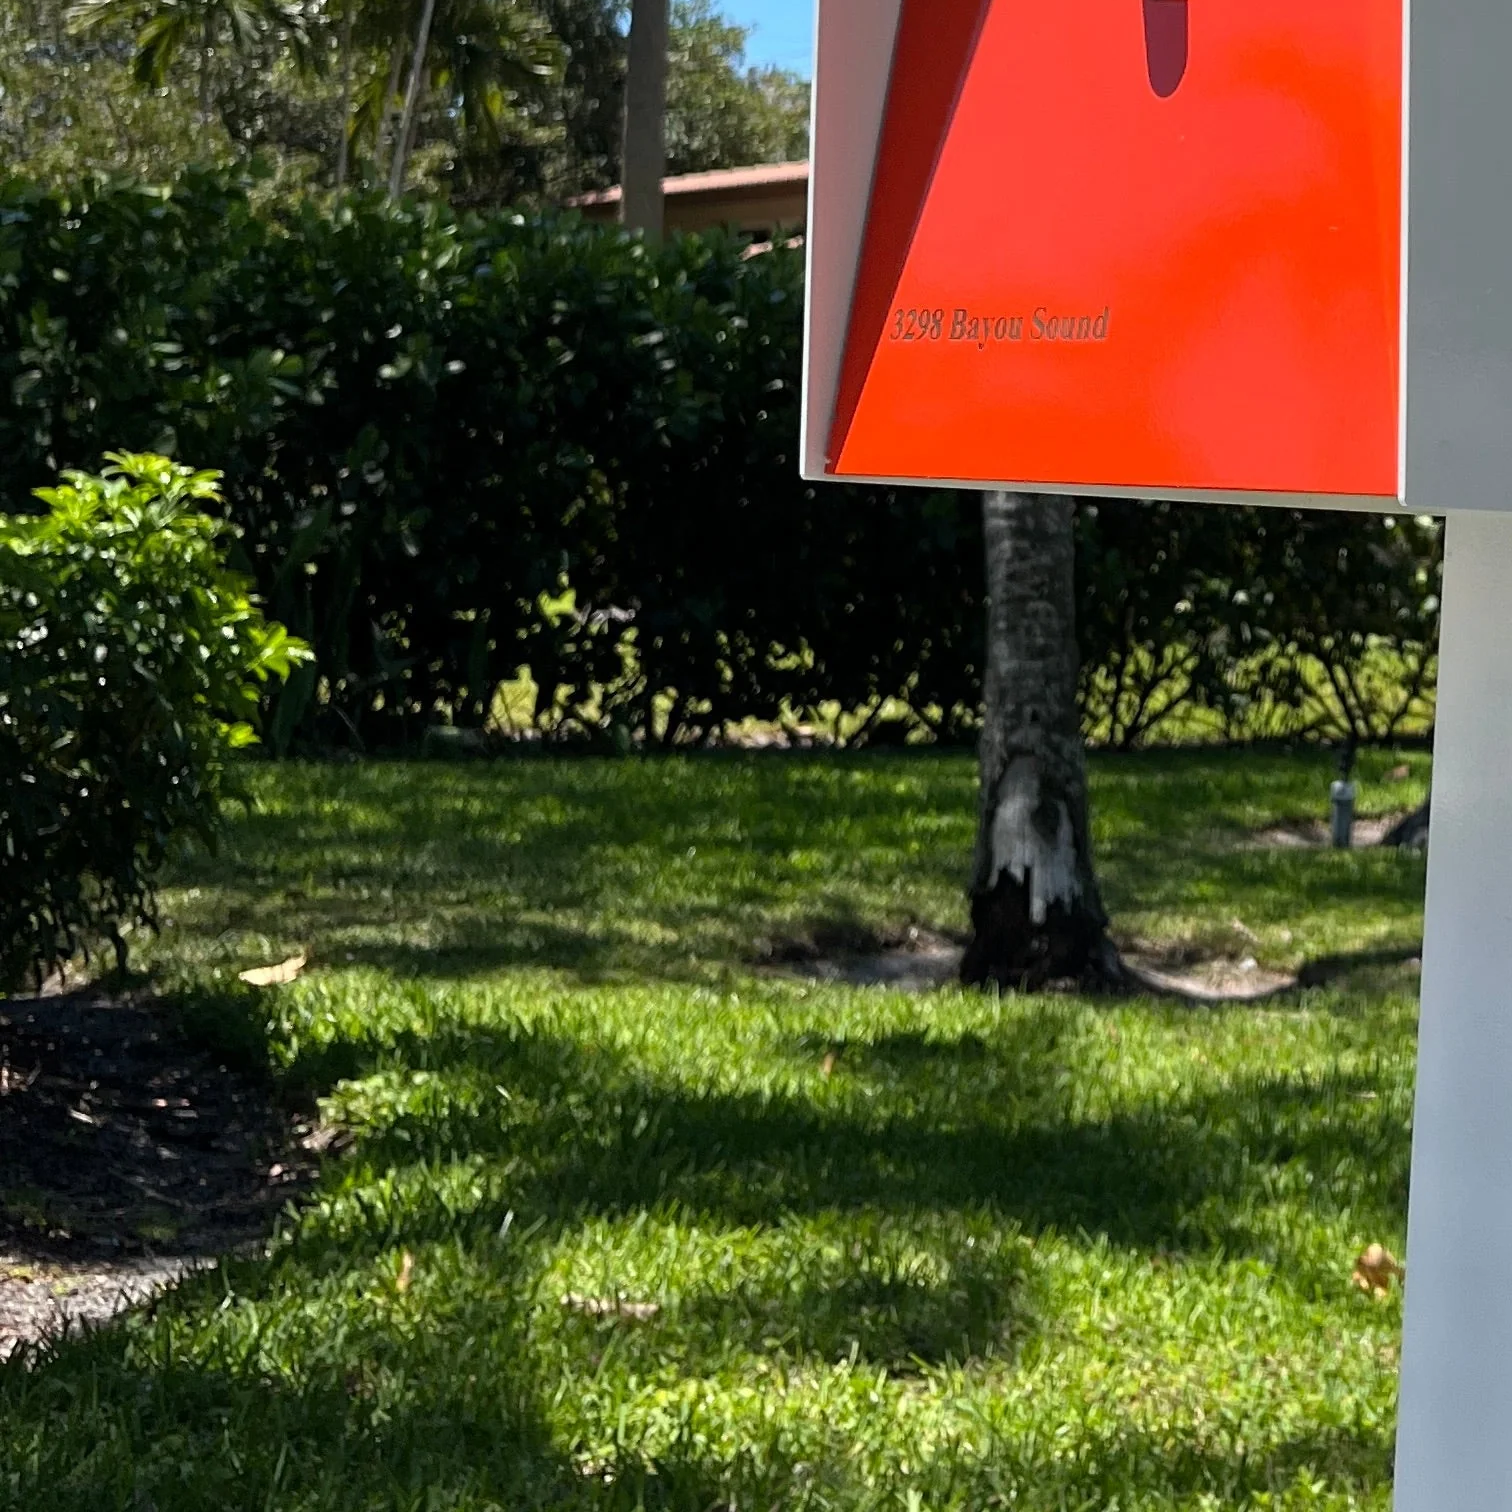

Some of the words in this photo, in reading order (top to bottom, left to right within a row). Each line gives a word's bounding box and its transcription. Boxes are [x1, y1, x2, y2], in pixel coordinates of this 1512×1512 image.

[890, 308, 945, 341] 3298
[949, 308, 1023, 349] Bayou
[1030, 306, 1110, 340] Sound
